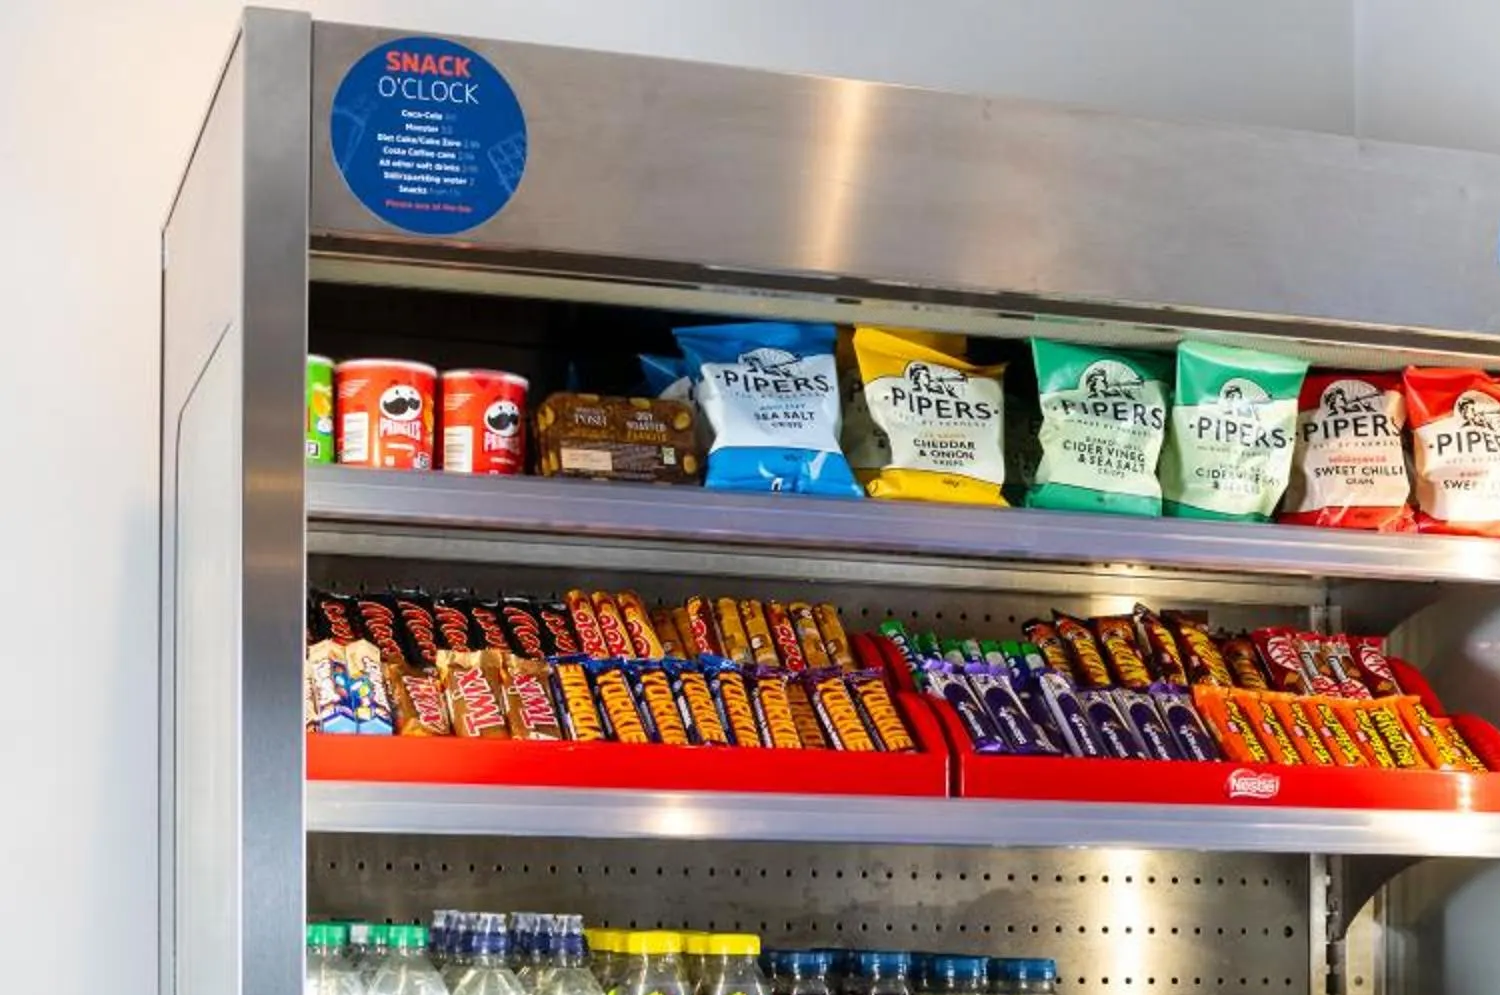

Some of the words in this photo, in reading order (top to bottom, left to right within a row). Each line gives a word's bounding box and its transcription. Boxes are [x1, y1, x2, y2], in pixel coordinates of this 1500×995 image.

[386, 51, 471, 77] SNACK
[378, 76, 479, 104] O'CLOCK
[723, 370, 829, 393] PIPERS
[754, 412, 779, 421] SEA
[783, 411, 815, 421] SALT
[891, 387, 992, 420] PIPERS
[1061, 400, 1163, 430] PIPERS
[1198, 416, 1286, 449] PIPERS
[1302, 414, 1401, 442] PIPERS
[914, 438, 975, 449] CHEDDAR
[930, 450, 975, 460] ONION
[1063, 440, 1103, 455] CIDER
[1089, 455, 1113, 468] SEA
[1117, 460, 1145, 473] SALT
[1314, 466, 1356, 477] SWEET
[1361, 465, 1403, 476] CHILLI
[597, 669, 648, 743] YORKIE
[642, 671, 687, 744] YORKIE
[680, 673, 728, 743] YORKIE
[718, 673, 761, 746] YORKIE
[758, 678, 801, 748] YORKIE
[816, 677, 875, 751] YORKIE
[857, 679, 913, 751] YORKIE
